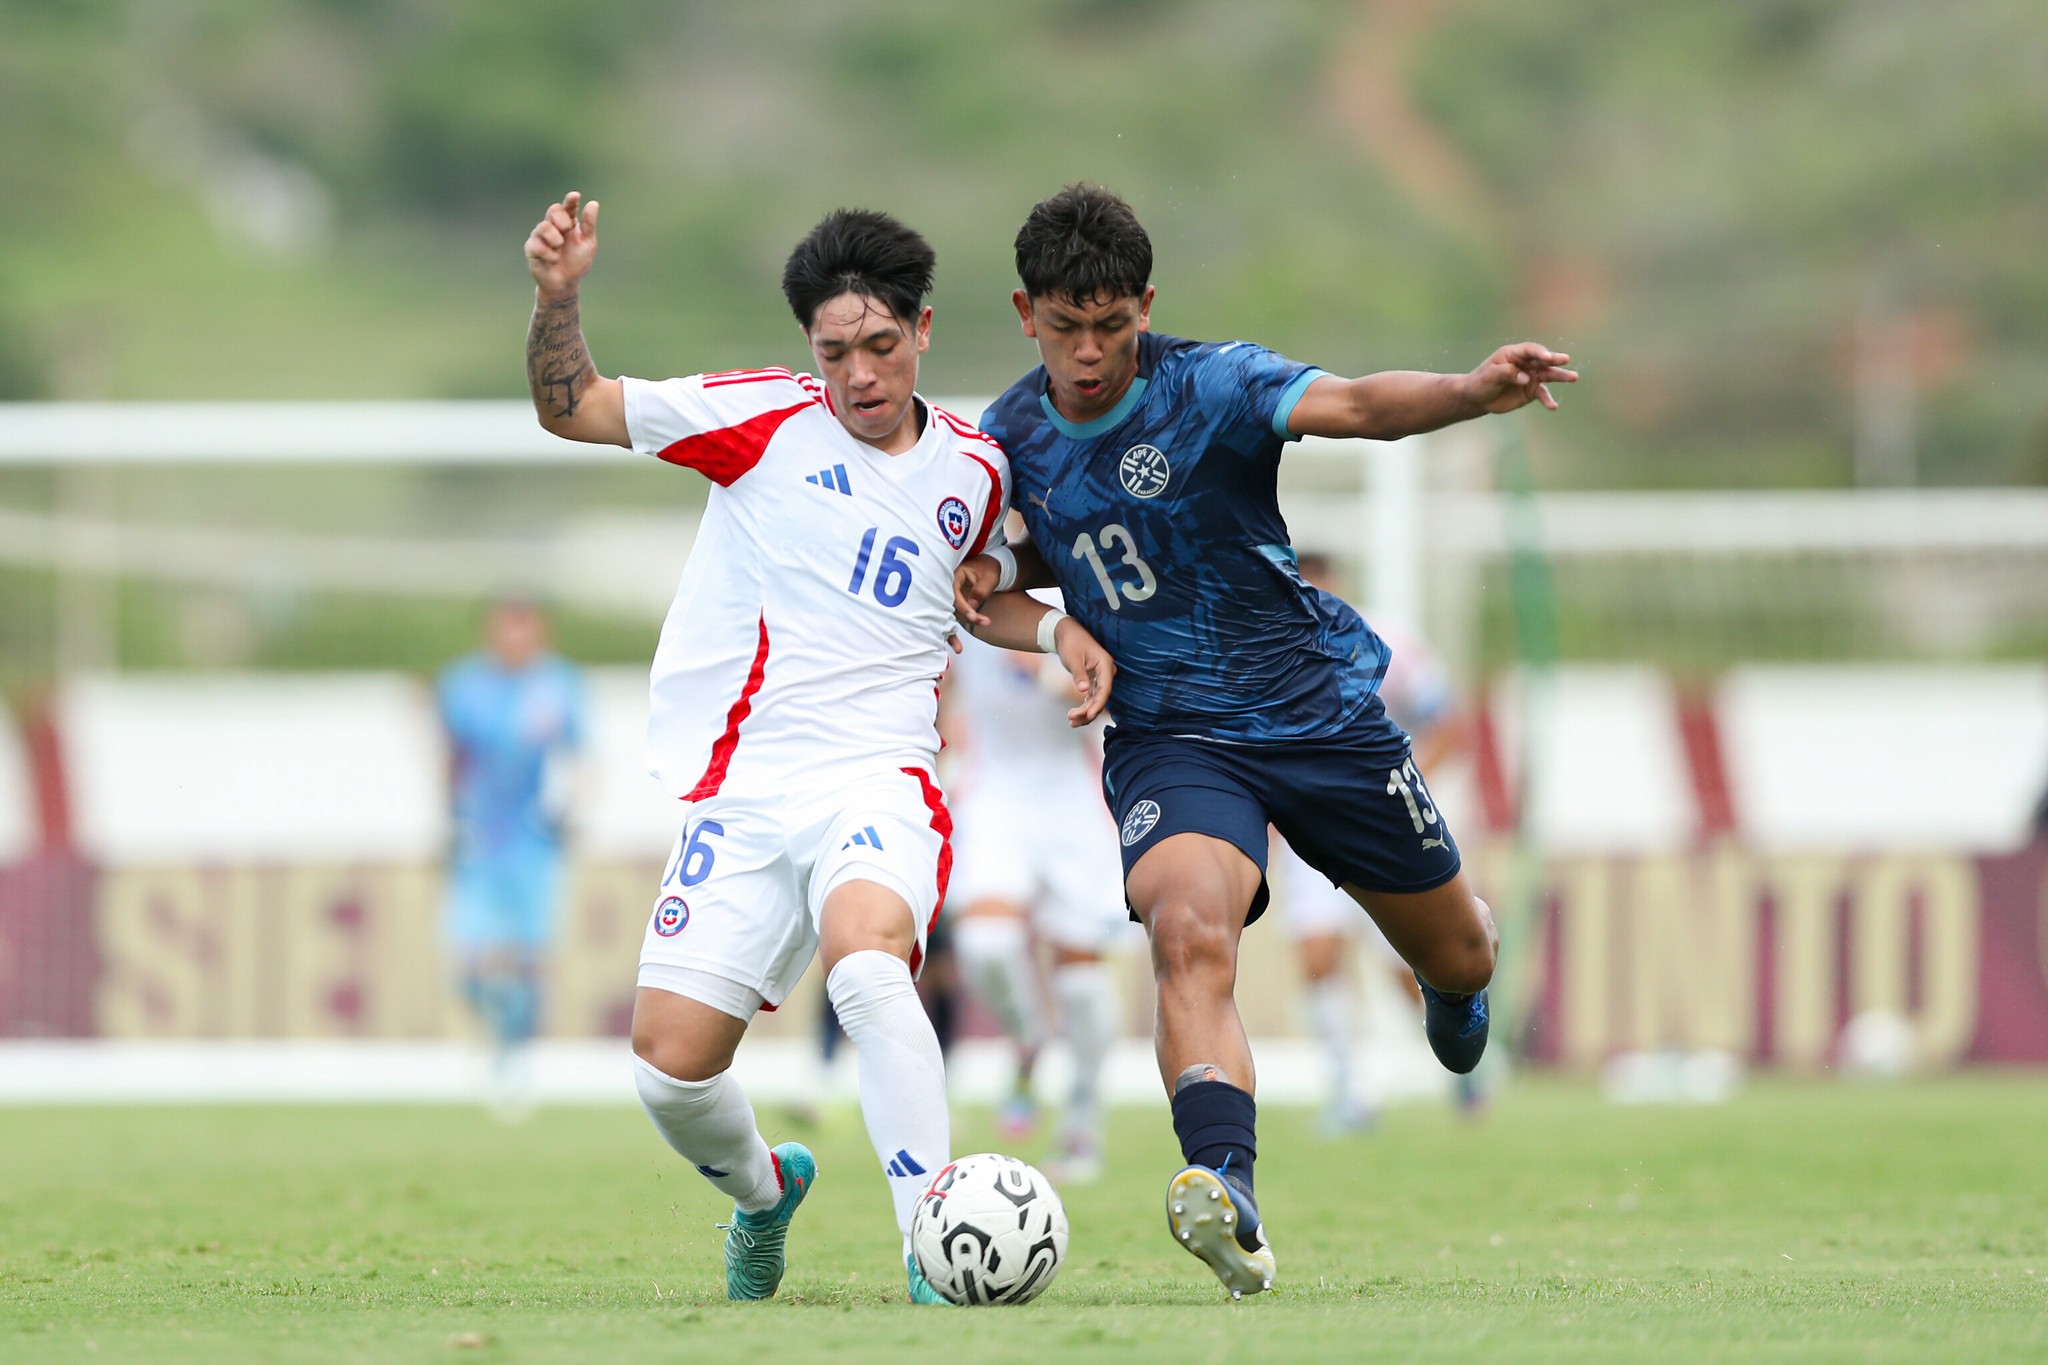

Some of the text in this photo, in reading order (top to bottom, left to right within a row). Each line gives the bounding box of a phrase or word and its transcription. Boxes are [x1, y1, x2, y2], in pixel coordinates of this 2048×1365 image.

[1132, 447, 1148, 460] APF
[848, 527, 920, 608] 16
[1072, 524, 1157, 610] 13
[1387, 756, 1438, 833] 13
